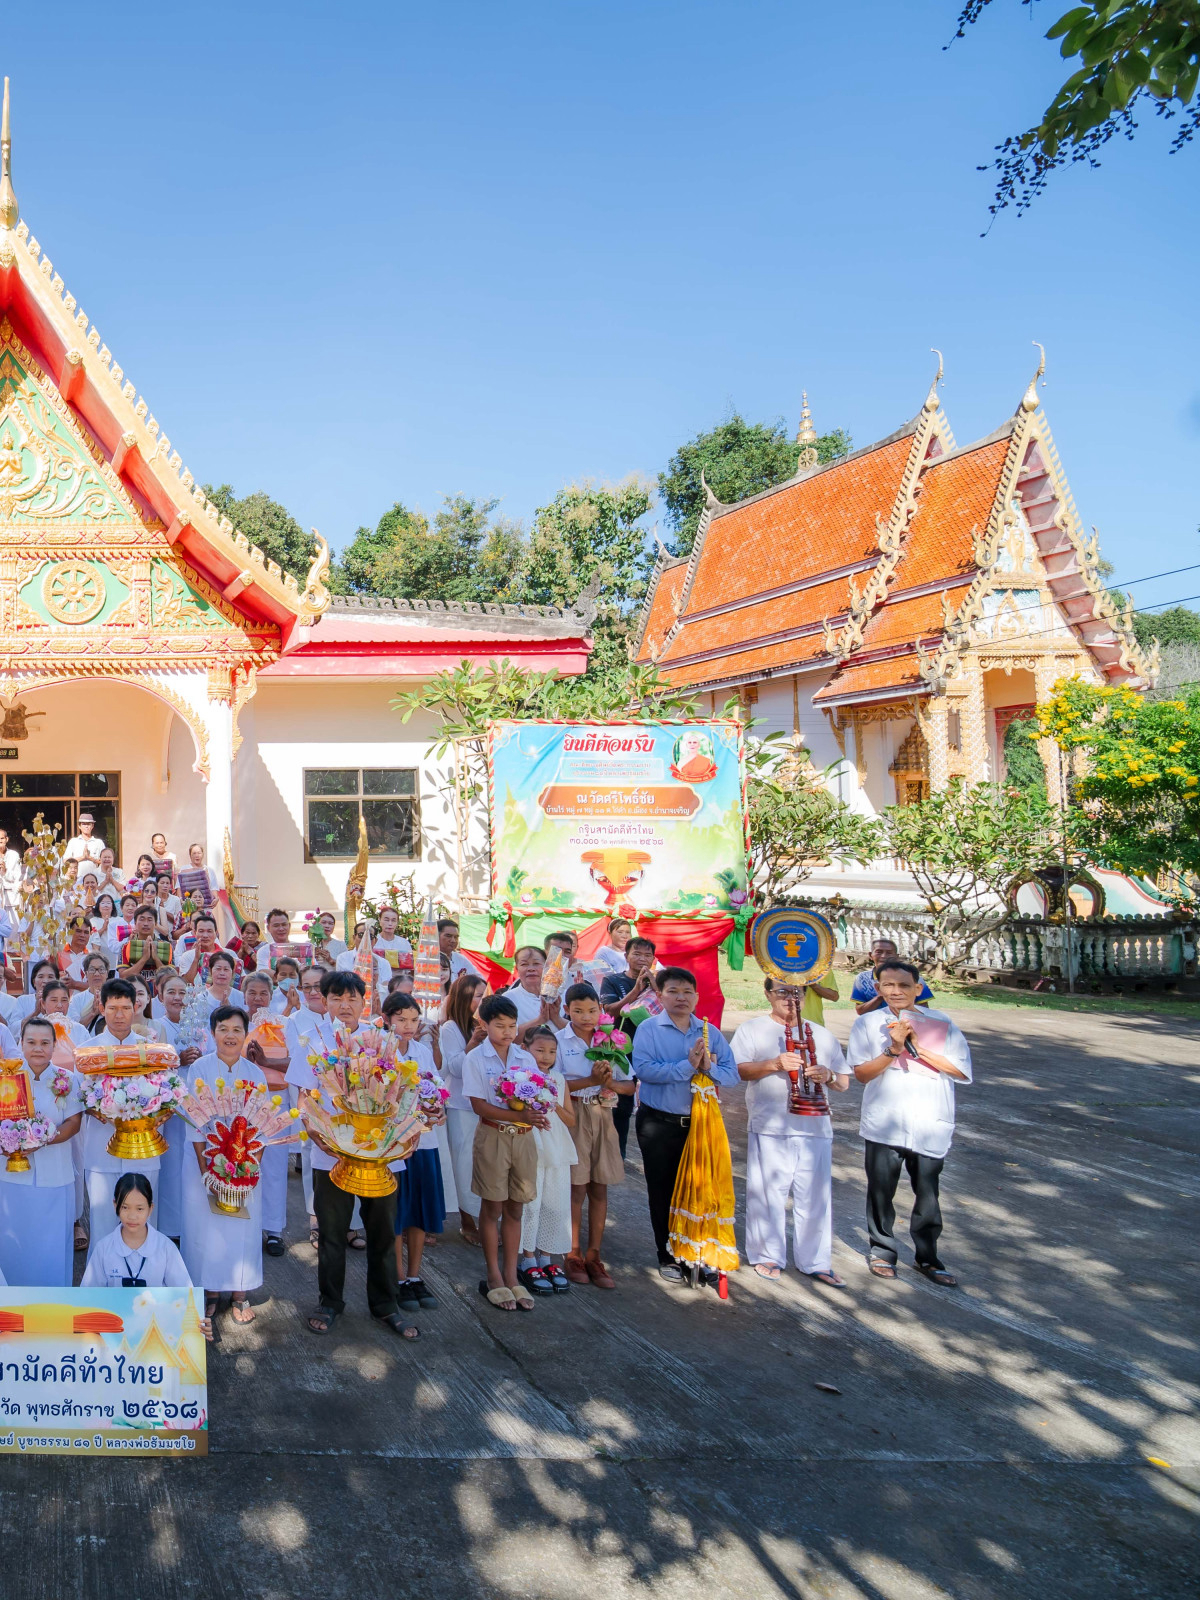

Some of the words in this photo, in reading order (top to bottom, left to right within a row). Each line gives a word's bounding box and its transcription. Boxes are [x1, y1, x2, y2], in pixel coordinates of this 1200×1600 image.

[563, 733, 656, 756] ยินดีต้อนรับ
[589, 787, 655, 804] วัดศรีโพธิ์ชัย
[578, 821, 654, 837] กฐินสามัคคีทั่วไทย
[0, 1397, 21, 1415] วัด
[26, 1398, 115, 1422] พุทธศักราช
[122, 1399, 198, 1419] ๒๕๖๘
[17, 1436, 70, 1449] บูชาธรรม
[73, 1437, 90, 1448] ๘๑
[94, 1434, 103, 1448] ปี
